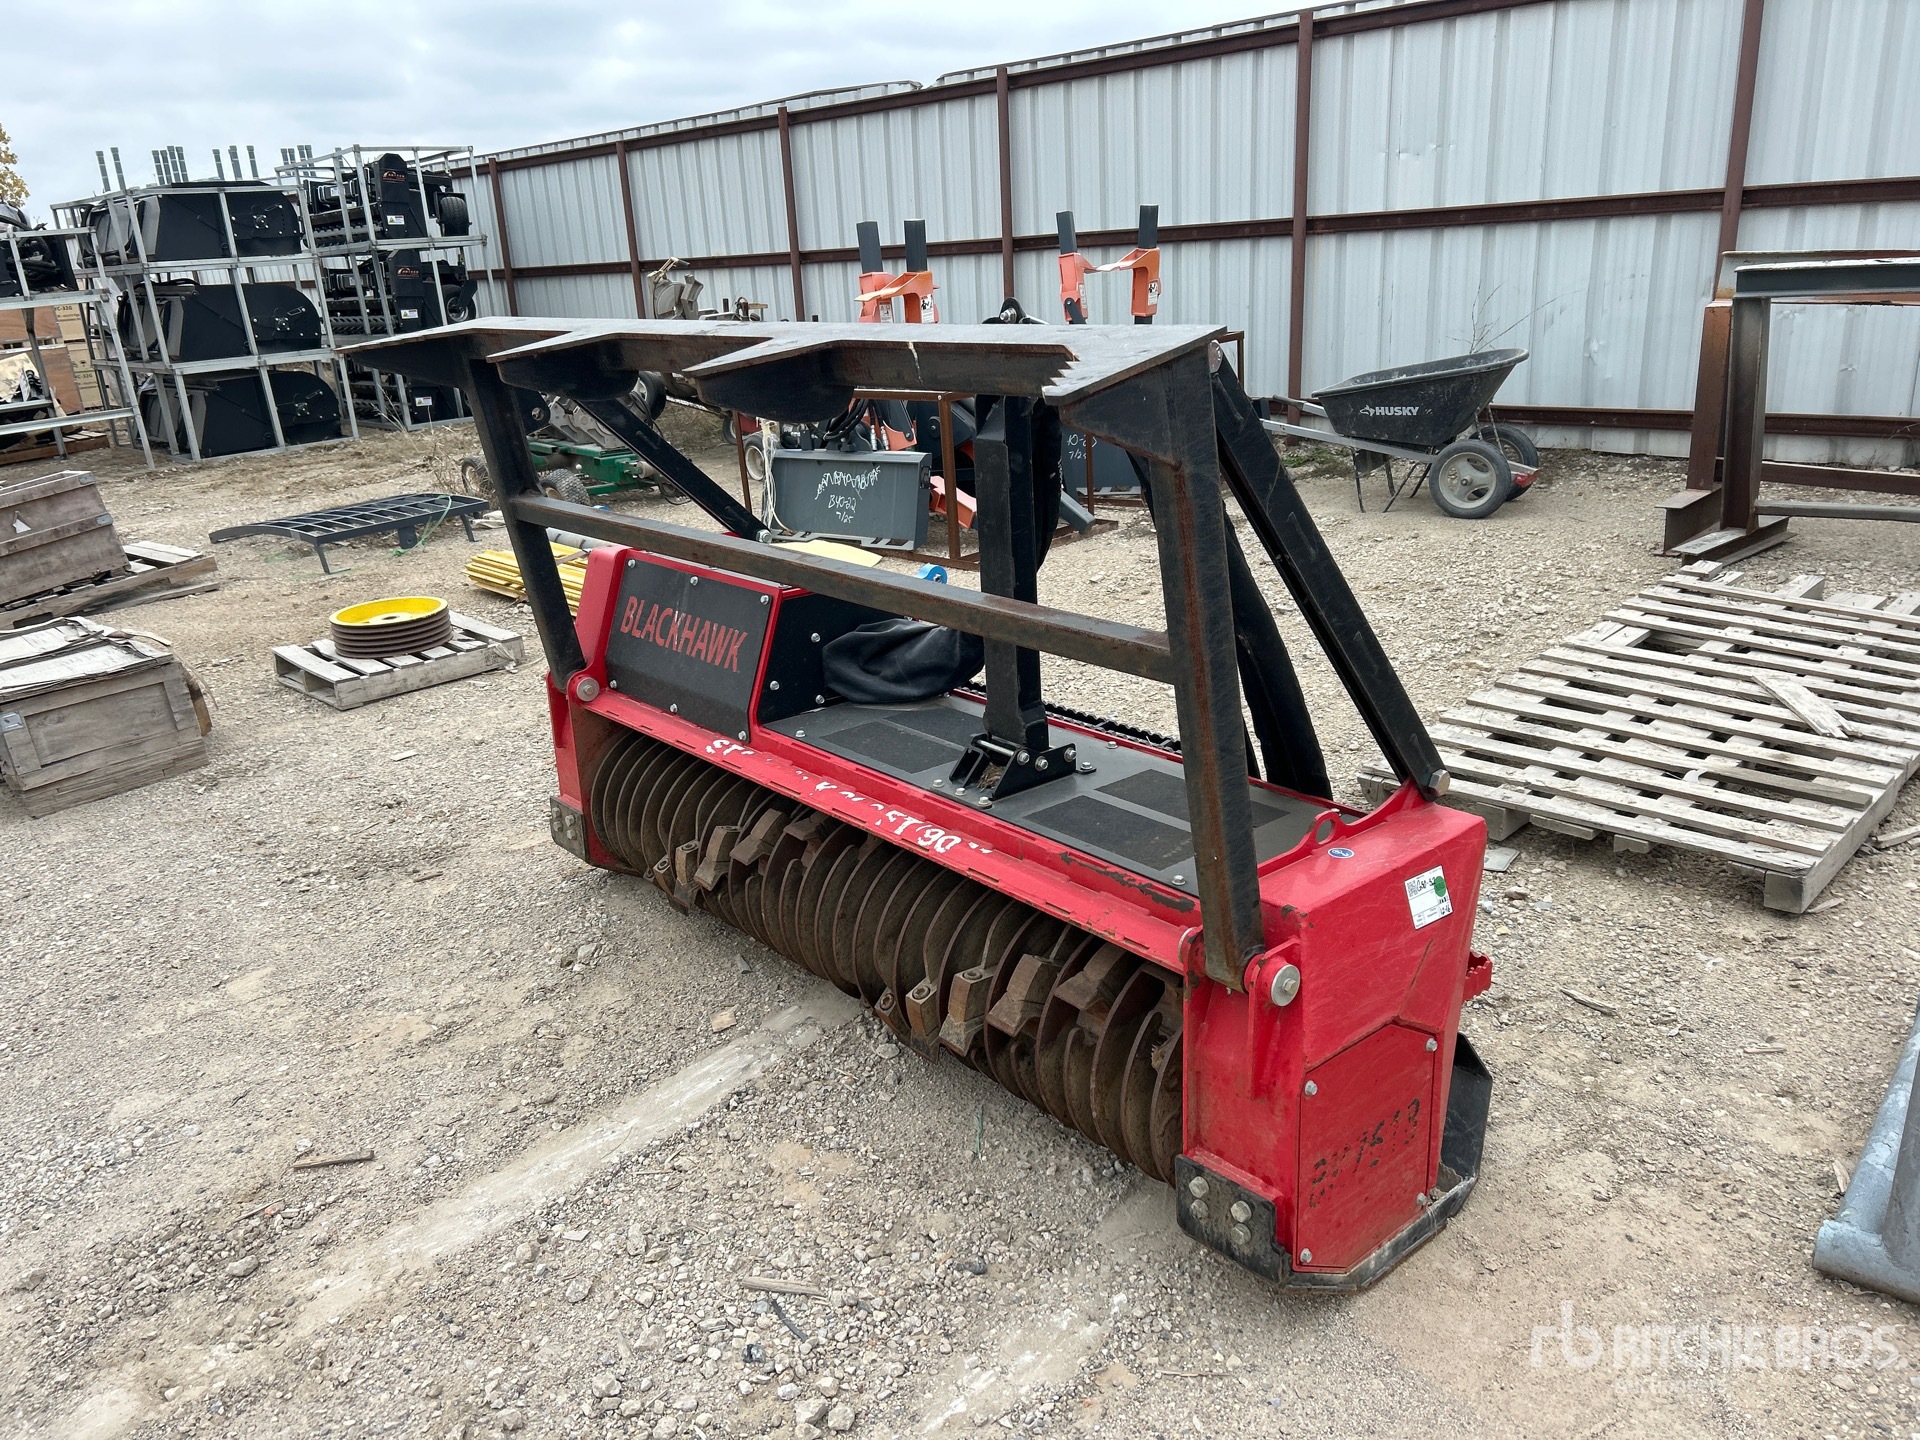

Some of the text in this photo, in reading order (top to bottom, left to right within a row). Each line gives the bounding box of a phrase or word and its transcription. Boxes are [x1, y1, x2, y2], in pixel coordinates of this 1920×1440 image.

[1375, 406, 1419, 416] HUSKY
[828, 494, 857, 513] B40-22
[836, 511, 854, 523] 7/25
[620, 595, 748, 673] BLACKHAWK
